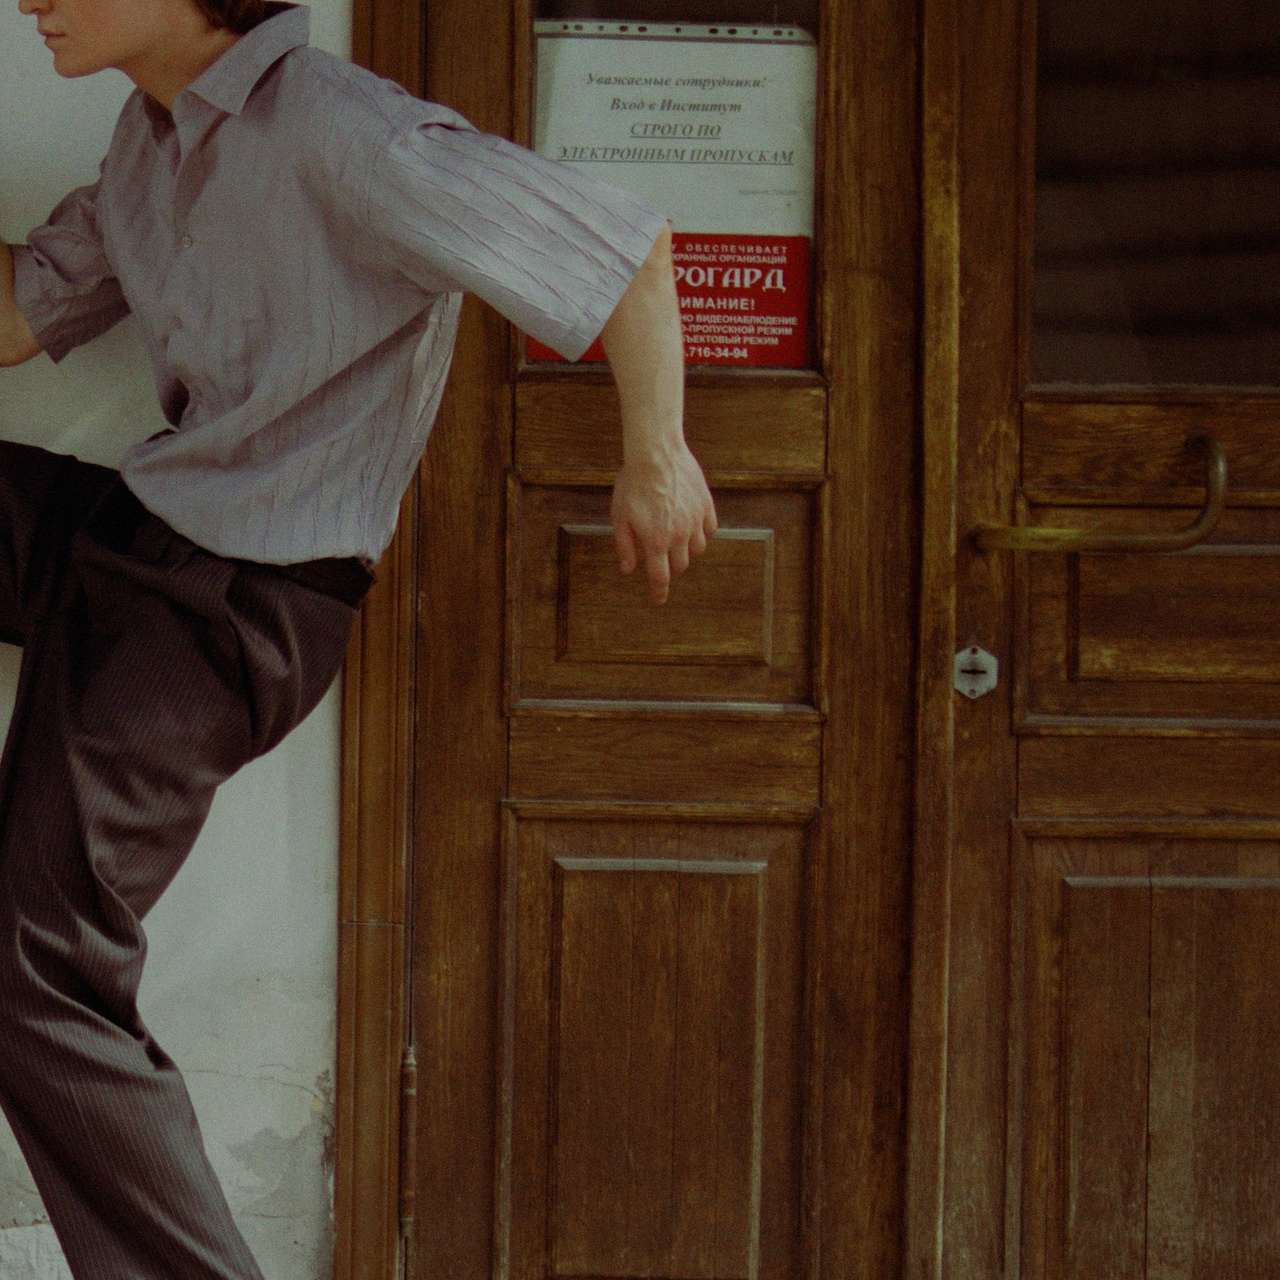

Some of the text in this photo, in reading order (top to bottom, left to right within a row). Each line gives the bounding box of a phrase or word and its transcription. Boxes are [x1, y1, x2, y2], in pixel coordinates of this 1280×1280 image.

[586, 73, 768, 90] Уважаемые сотрудники!
[610, 97, 742, 115] Вход в Институт
[630, 123, 722, 138] СТРОГО ПО
[558, 145, 794, 164] ЭЛЕКТРОННЫМ ПРОПУСКАМ
[685, 243, 788, 254] ОБЕСПЕЧИВАЕТ
[673, 253, 787, 265] ХРАННЫХ ОРГАНИЗАЦИЙ
[674, 266, 787, 293] РОГАРД
[680, 296, 756, 310] ИМАНИЕ!
[696, 314, 799, 326] ВИДЕОНАБЛЮДЕНИЕ
[757, 326, 793, 336] РЕЖИМ
[743, 335, 779, 345] РЕЖИМ
[685, 346, 749, 358] .716-34-94
